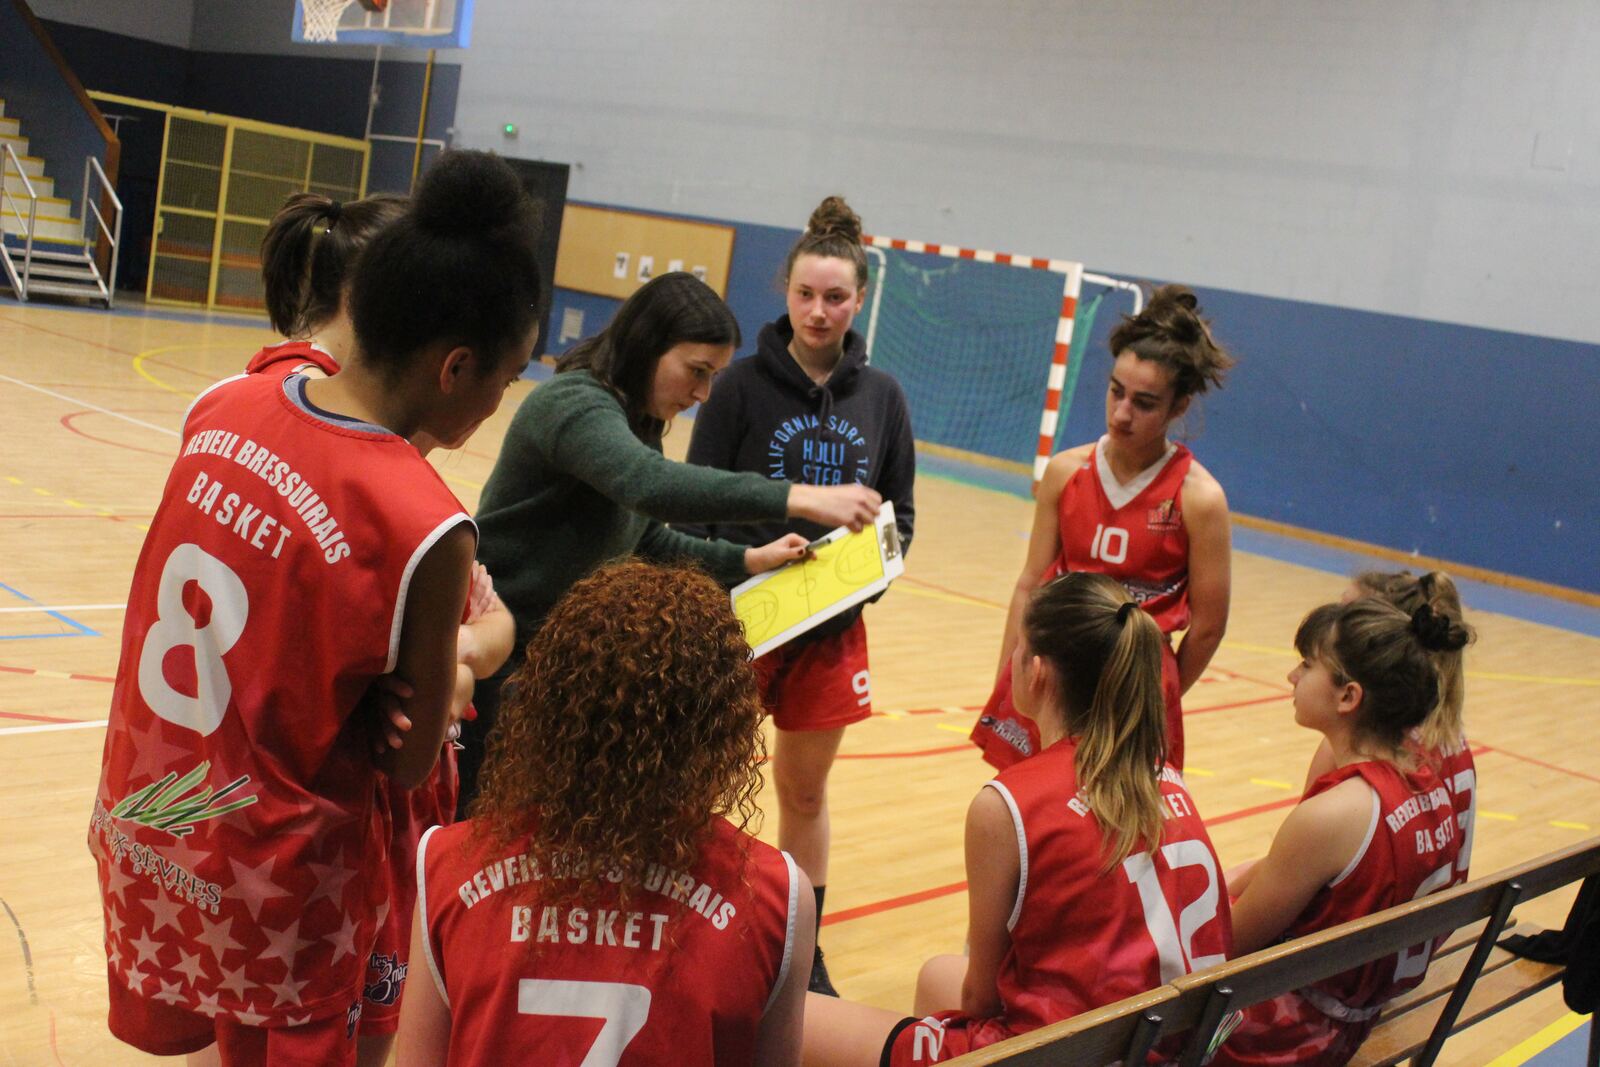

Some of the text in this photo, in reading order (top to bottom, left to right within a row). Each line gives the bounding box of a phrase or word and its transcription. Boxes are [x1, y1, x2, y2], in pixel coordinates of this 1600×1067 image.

[768, 414, 820, 479] ALIFORNIA
[827, 415, 866, 448] SURF
[183, 429, 351, 565] REVEIL BRESSUIRAIS
[186, 471, 292, 559] BASKET
[1090, 523, 1130, 564] 10
[138, 543, 249, 737] 8
[852, 669, 872, 707] 9
[510, 904, 669, 951] BASKET
[1123, 839, 1227, 987] 12
[517, 978, 652, 1067] 7
